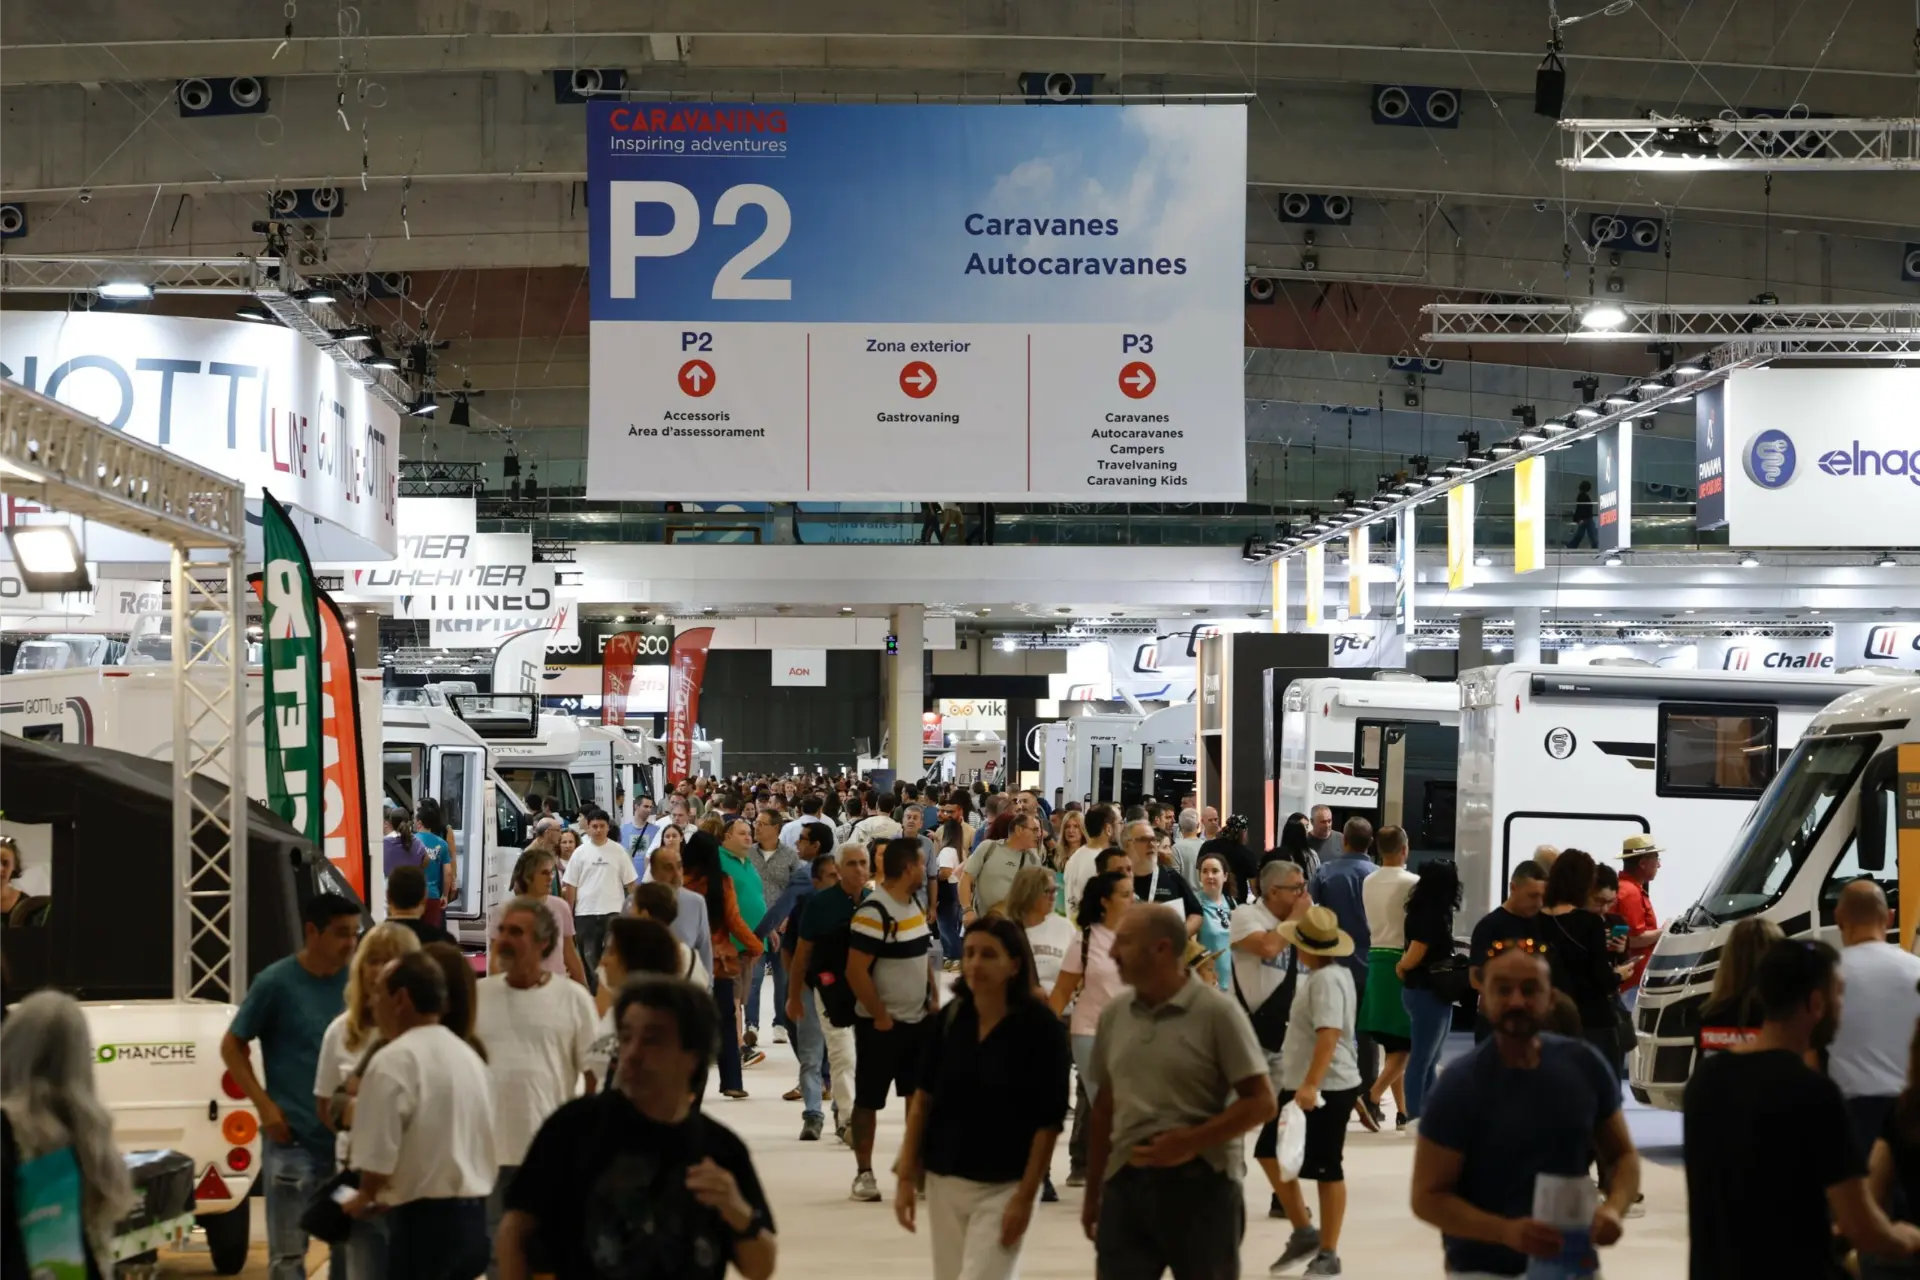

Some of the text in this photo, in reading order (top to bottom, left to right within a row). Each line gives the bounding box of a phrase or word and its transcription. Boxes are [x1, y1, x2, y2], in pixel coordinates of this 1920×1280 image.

[610, 108, 787, 133] CARAVANING
[610, 136, 787, 154] Inspiring adventures
[964, 212, 1119, 236] Caravanes
[610, 180, 792, 300] P2
[964, 252, 1187, 275] Autocaravanes
[681, 332, 713, 352] P2
[866, 339, 971, 353] Zona exterior
[1122, 333, 1154, 354] P3
[663, 410, 730, 421] Accessoris
[876, 412, 960, 425] Gastrovaning
[1105, 412, 1170, 423] Caravanes
[628, 423, 662, 437] Àrea
[1091, 428, 1184, 439] Autocaravanes
[1110, 444, 1165, 456] Campers
[1097, 459, 1178, 472] Travelvaning
[1086, 475, 1188, 488] Caravaning Kids
[789, 668, 810, 676] AON
